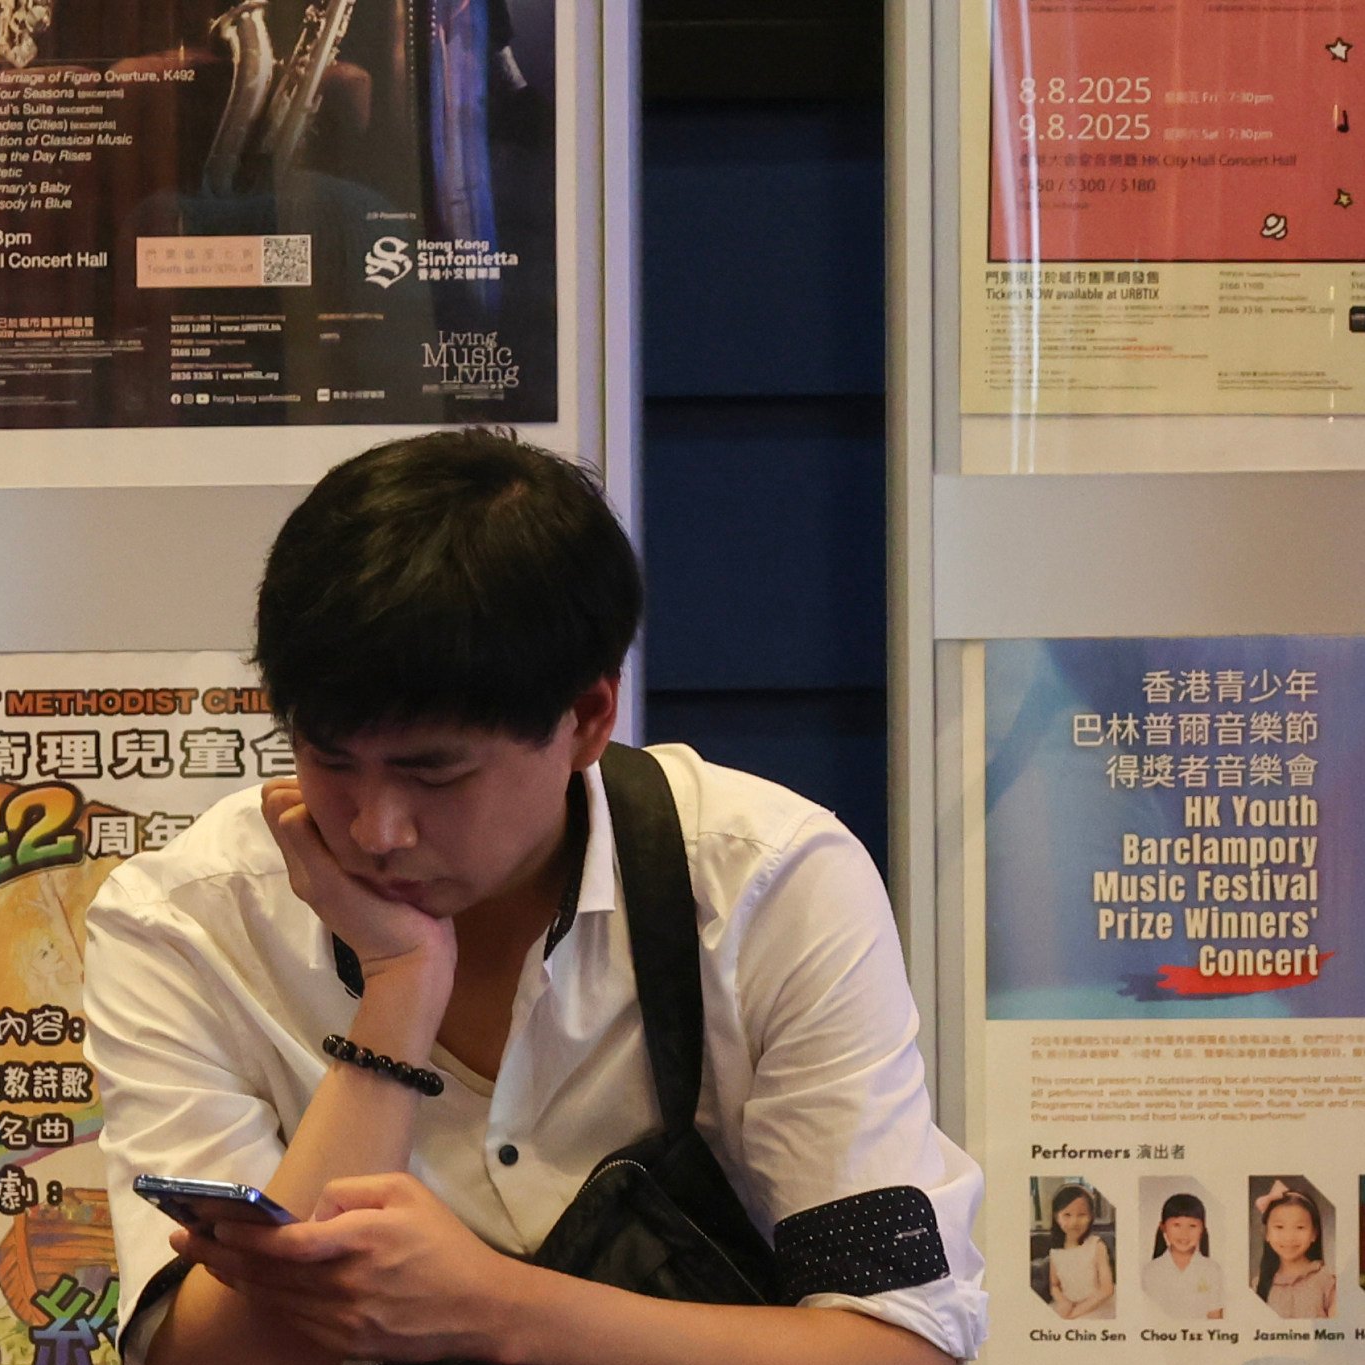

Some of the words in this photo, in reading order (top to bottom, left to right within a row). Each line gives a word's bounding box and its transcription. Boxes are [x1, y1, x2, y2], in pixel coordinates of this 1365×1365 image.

[48, 71, 62, 83] of
[63, 71, 101, 85] Figaro
[163, 69, 195, 81] K492
[1019, 77, 1151, 104] 8.8.2025
[1019, 113, 1150, 140] 9.8.2025
[25, 134, 38, 146] of
[41, 134, 94, 146] Classical
[97, 133, 132, 145] Music
[10, 150, 29, 162] the
[32, 150, 55, 164] Day
[59, 149, 92, 161] Rises
[40, 181, 71, 195] Baby
[30, 197, 41, 209] in
[45, 197, 72, 209] Blue
[417, 239, 451, 252] Hong
[455, 238, 490, 252] Kong
[8, 252, 73, 269] Concert
[77, 251, 108, 267] Hall
[417, 251, 519, 267] Sinfonietta
[1056, 288, 1104, 300] available
[1107, 288, 1118, 300] at
[1120, 287, 1159, 300] URBTIX
[439, 330, 498, 349] Living
[422, 342, 513, 367] Music
[440, 364, 520, 388] Living
[1142, 669, 1318, 704] 香港青少年
[6, 689, 198, 717] METHODIST
[1073, 711, 1319, 747] 巴林普爾音樂節
[1105, 753, 1319, 789] 得獎者音樂會
[1184, 796, 1221, 828] HK
[1232, 795, 1318, 828] Youth
[1122, 833, 1318, 870] Barclampory
[1093, 870, 1185, 902] Music
[1197, 869, 1318, 902] Festival
[1098, 908, 1172, 940] Prize
[1184, 907, 1319, 940] Winners'
[1198, 944, 1319, 978] Concert
[1031, 1143, 1130, 1160] Performers
[1136, 1144, 1186, 1160] 演出者
[1030, 1329, 1061, 1341] Chiu
[1065, 1329, 1096, 1341] Chin
[1101, 1329, 1125, 1341] Sen
[1141, 1329, 1177, 1341] Chou
[1207, 1329, 1239, 1344] Ying
[1253, 1328, 1310, 1341] Jasmine
[1314, 1328, 1345, 1340] Man
